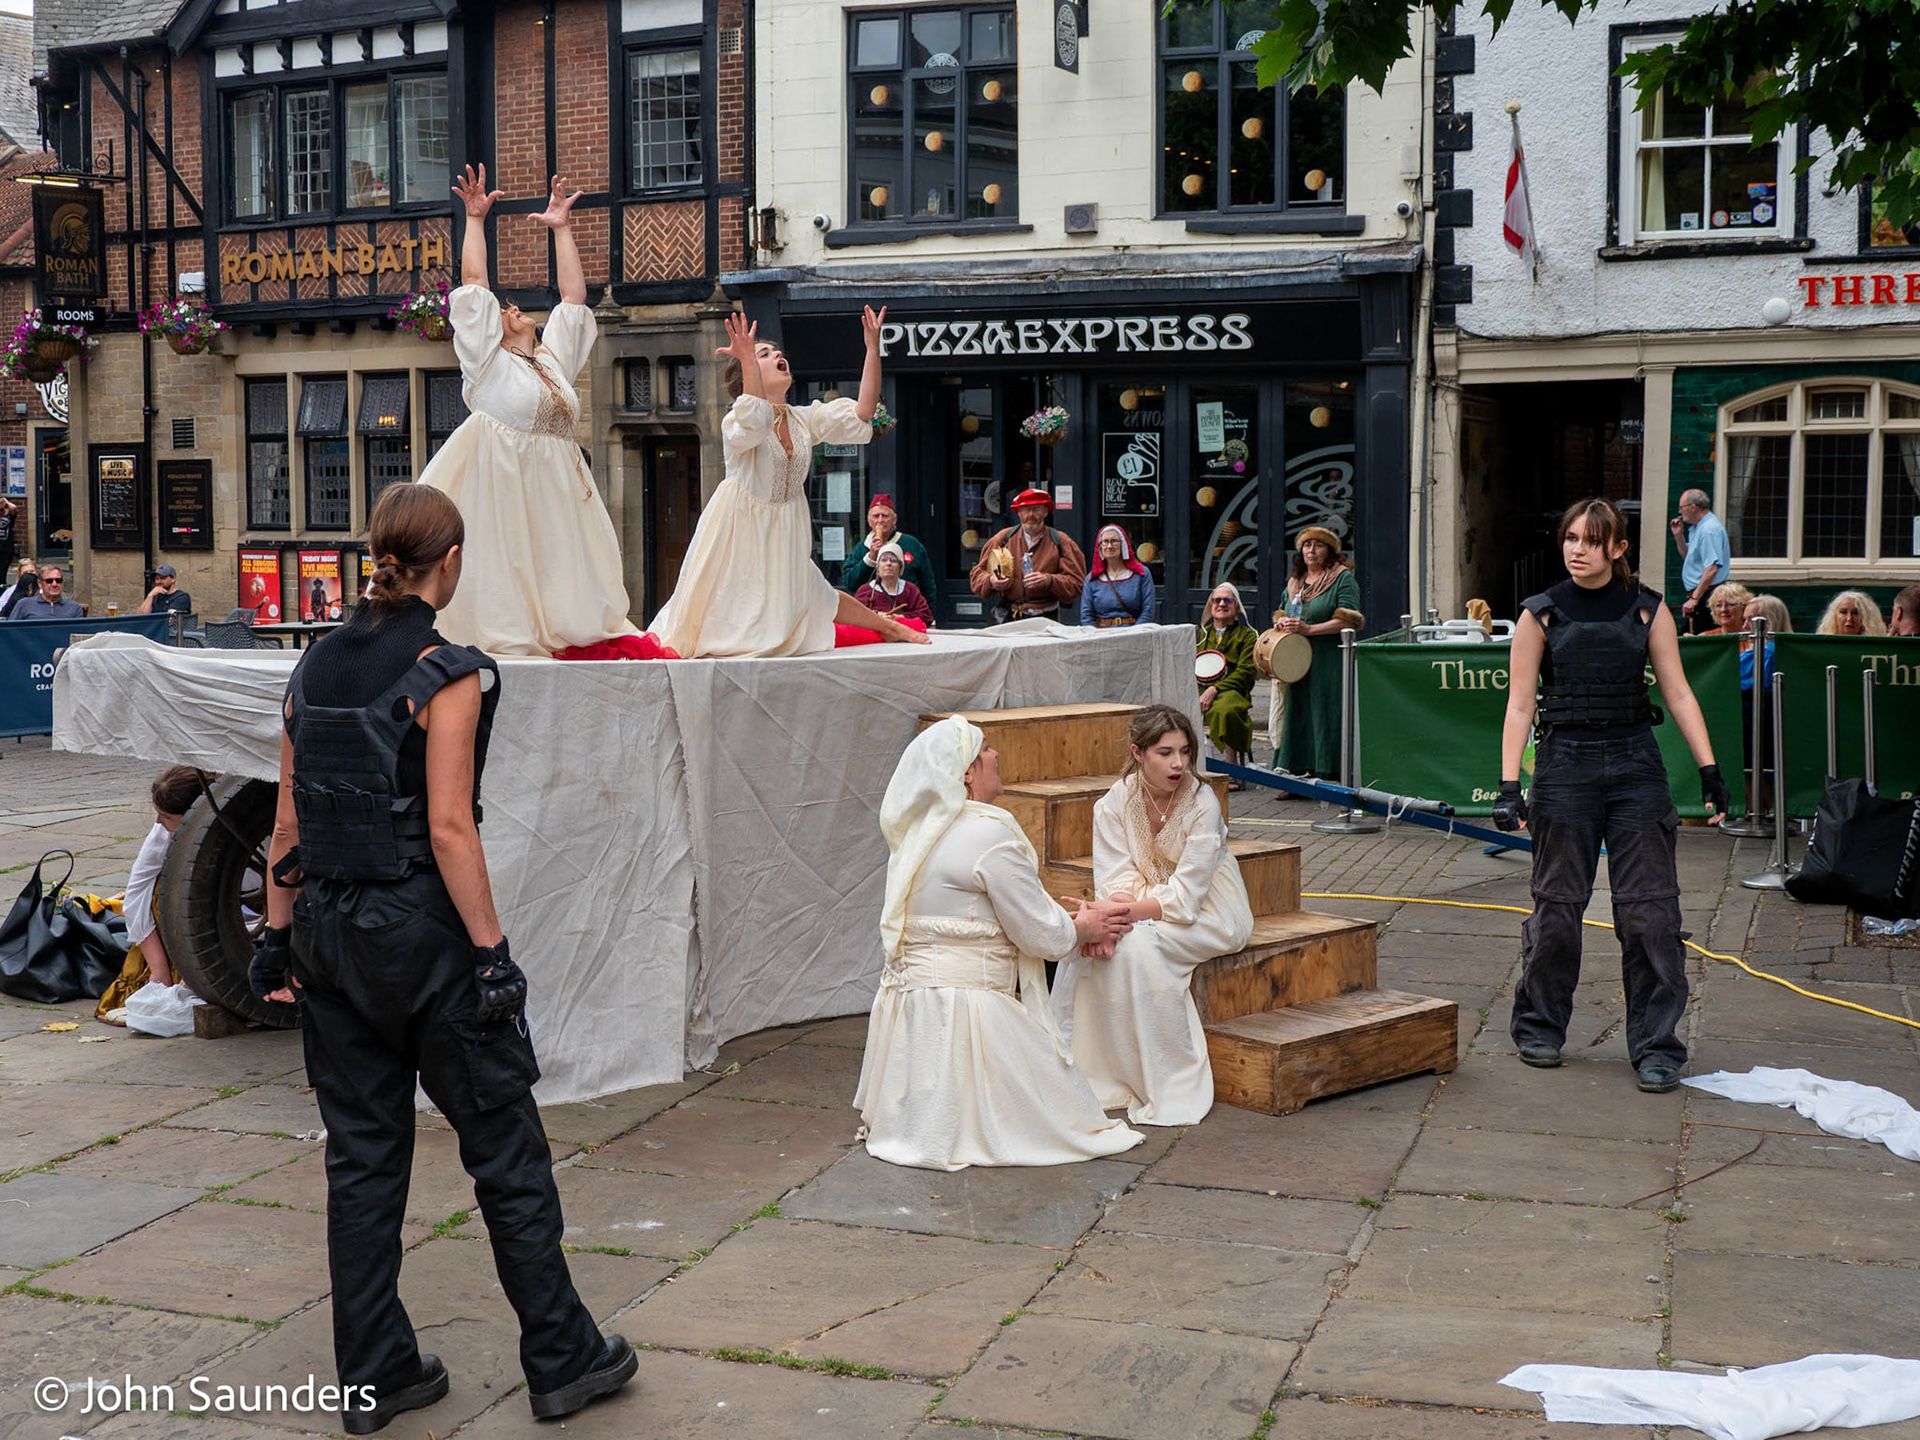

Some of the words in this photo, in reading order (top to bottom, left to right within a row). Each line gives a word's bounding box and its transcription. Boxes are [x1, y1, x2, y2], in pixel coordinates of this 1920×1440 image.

[45, 254, 98, 275] ROMAN
[222, 244, 344, 285] ROMAN
[357, 236, 444, 276] BATH
[56, 272, 89, 285] BATH
[1797, 274, 1920, 307] THRE
[57, 310, 95, 321] ROOMS
[880, 314, 1253, 357] PIZZAEXPRESS
[44, 382, 68, 400] VIC
[107, 469, 127, 477] MUSIC
[302, 563, 316, 572] LIVE
[316, 563, 338, 572] MUSIC
[31, 663, 54, 678] RO
[1431, 660, 1509, 690] Thre
